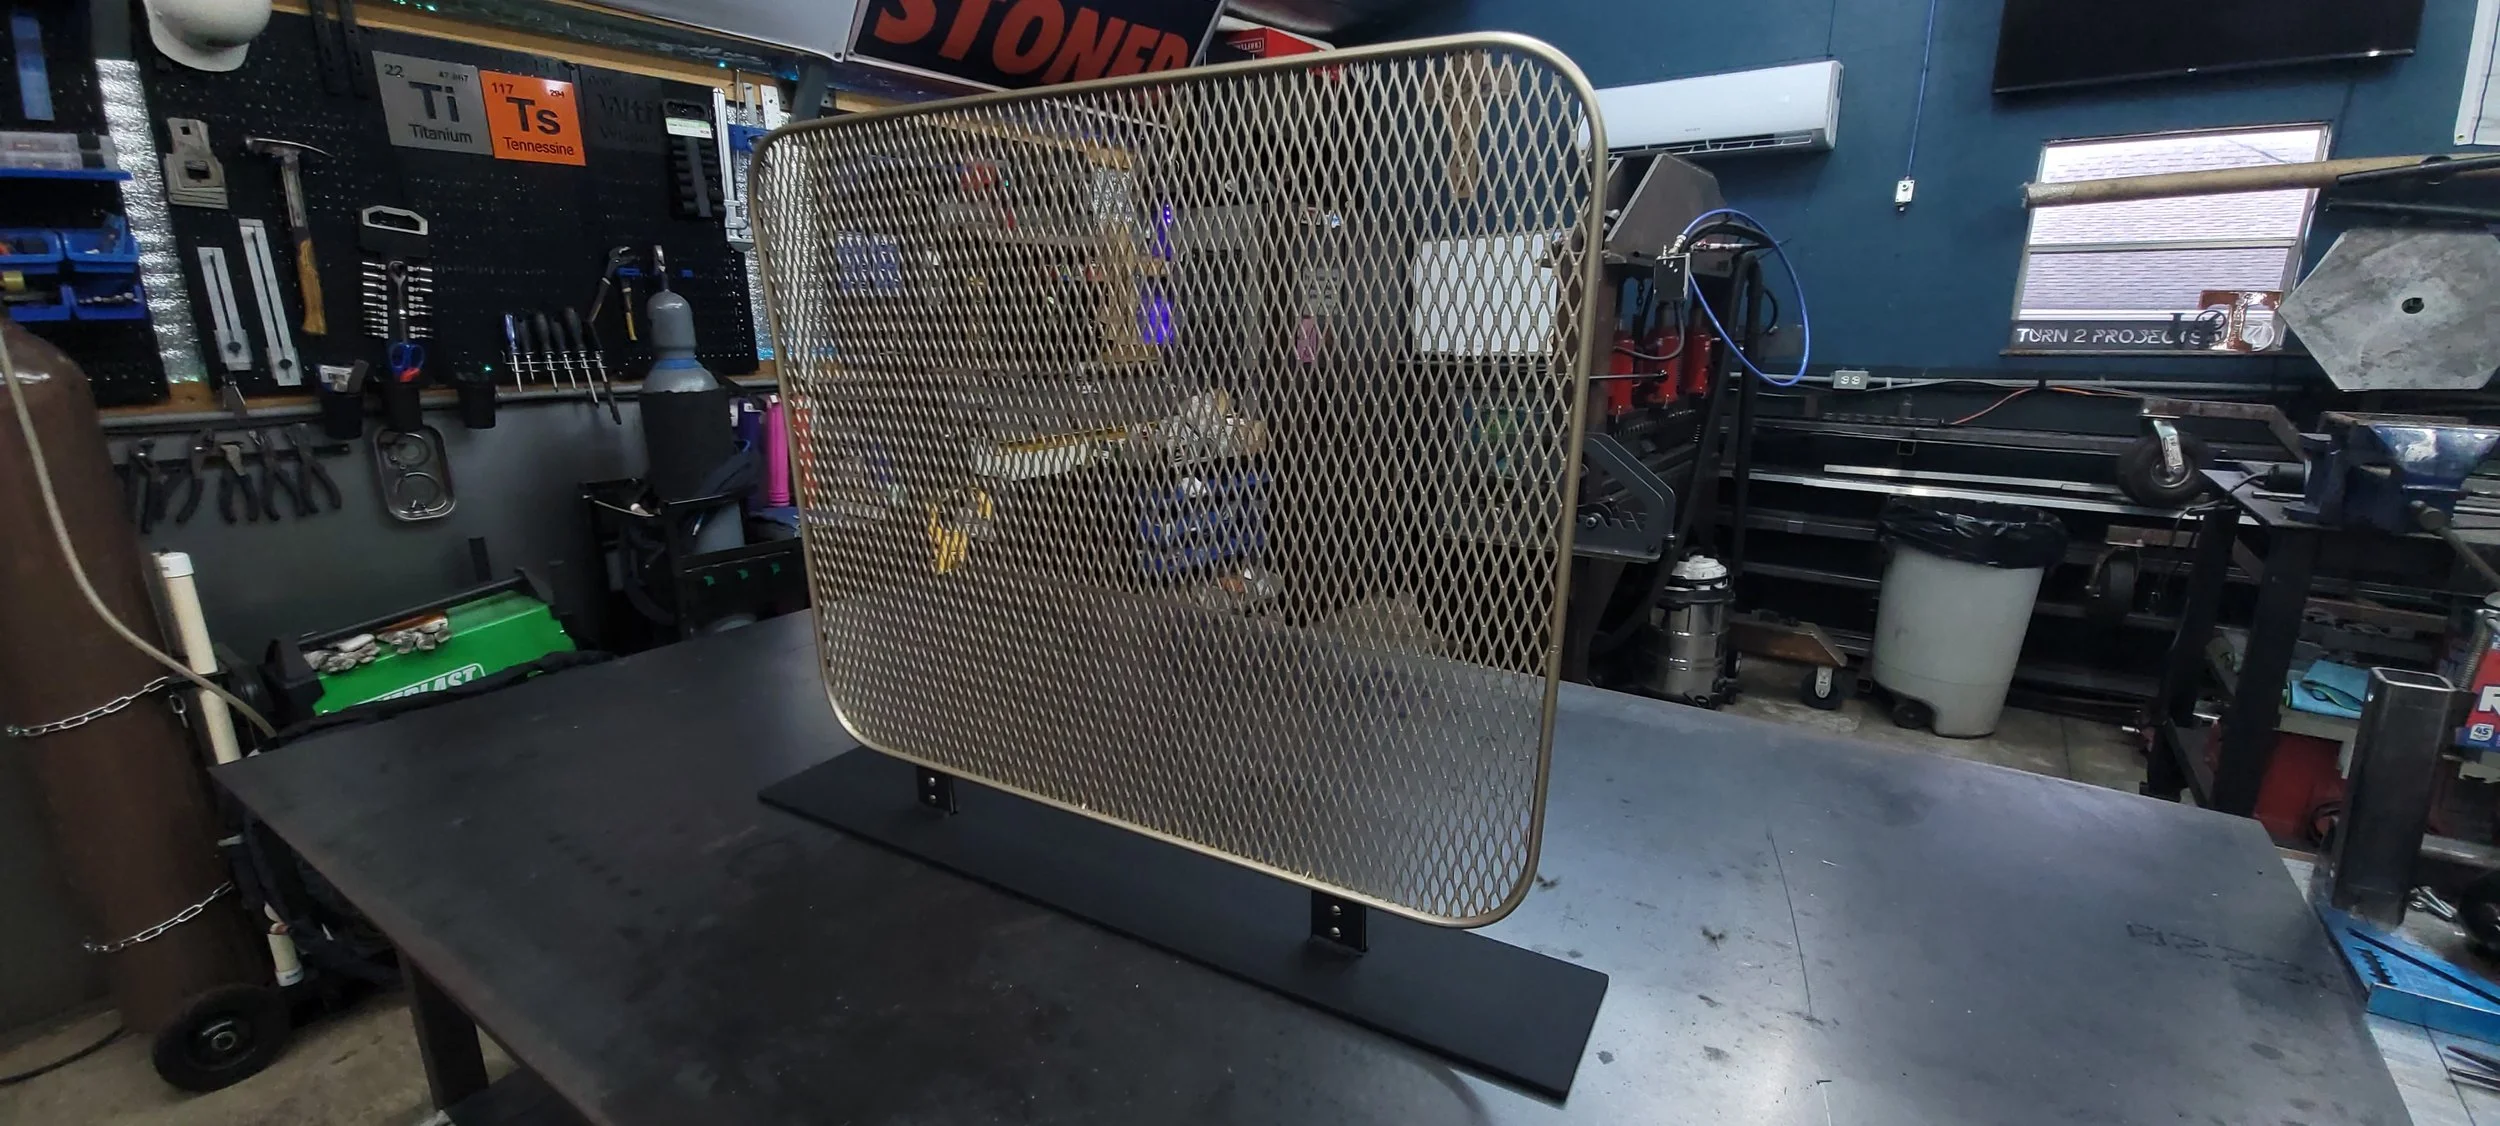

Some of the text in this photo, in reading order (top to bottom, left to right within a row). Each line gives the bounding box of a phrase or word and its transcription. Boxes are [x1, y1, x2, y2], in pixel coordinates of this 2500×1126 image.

[384, 64, 404, 78] 22
[491, 82, 514, 95] 117
[408, 80, 460, 123] Ti
[506, 96, 561, 135] Ts
[408, 123, 473, 144] Titanium
[503, 136, 575, 156] Tennessine
[2016, 327, 2067, 344] TURN
[2073, 328, 2087, 343] 2
